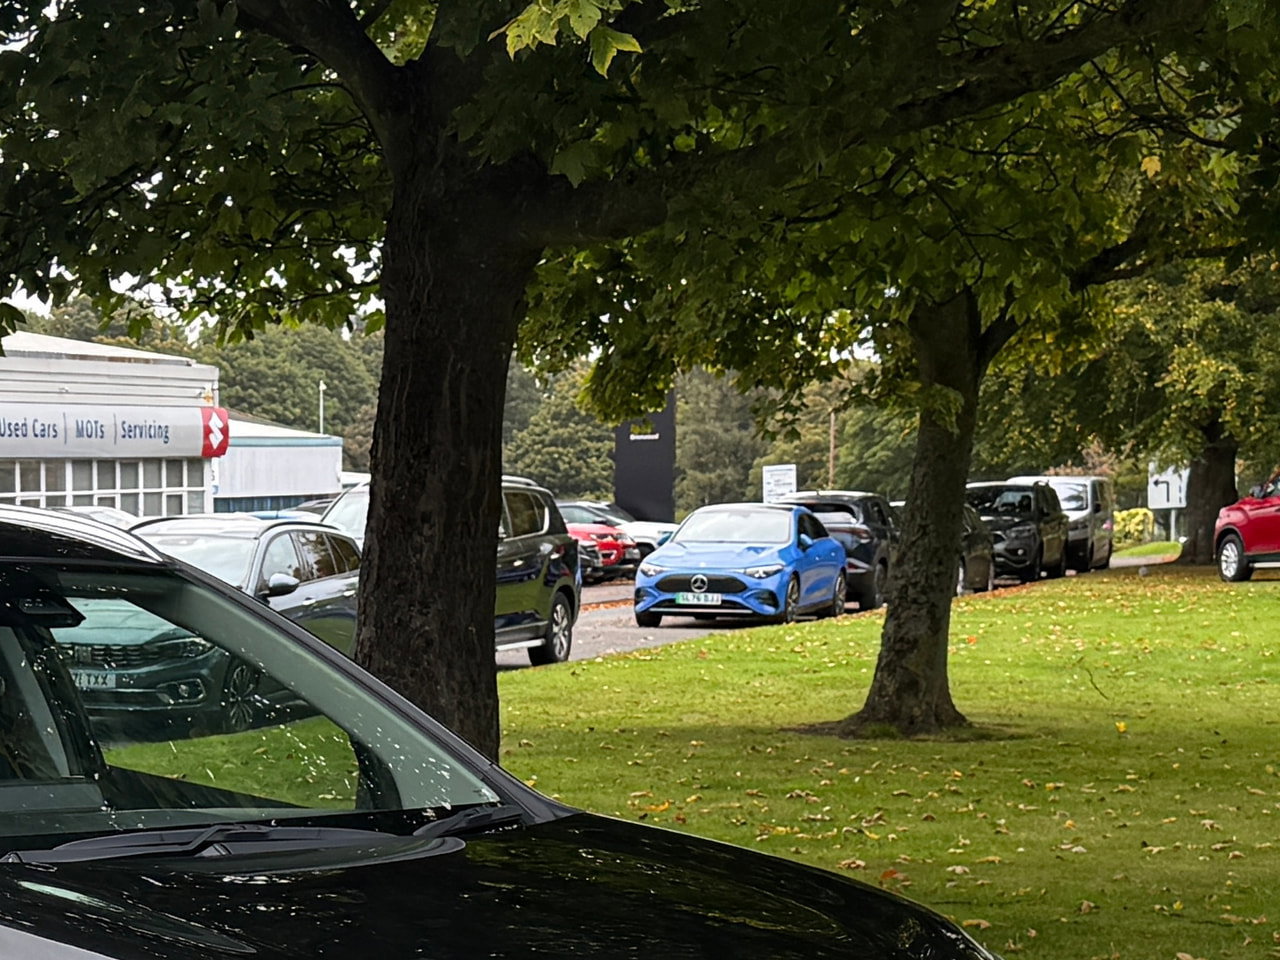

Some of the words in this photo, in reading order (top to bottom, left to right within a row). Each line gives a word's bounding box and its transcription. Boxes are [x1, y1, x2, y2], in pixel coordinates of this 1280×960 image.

[32, 418, 58, 439] Cars
[75, 419, 105, 439] MOTs
[121, 420, 170, 444] Servicing
